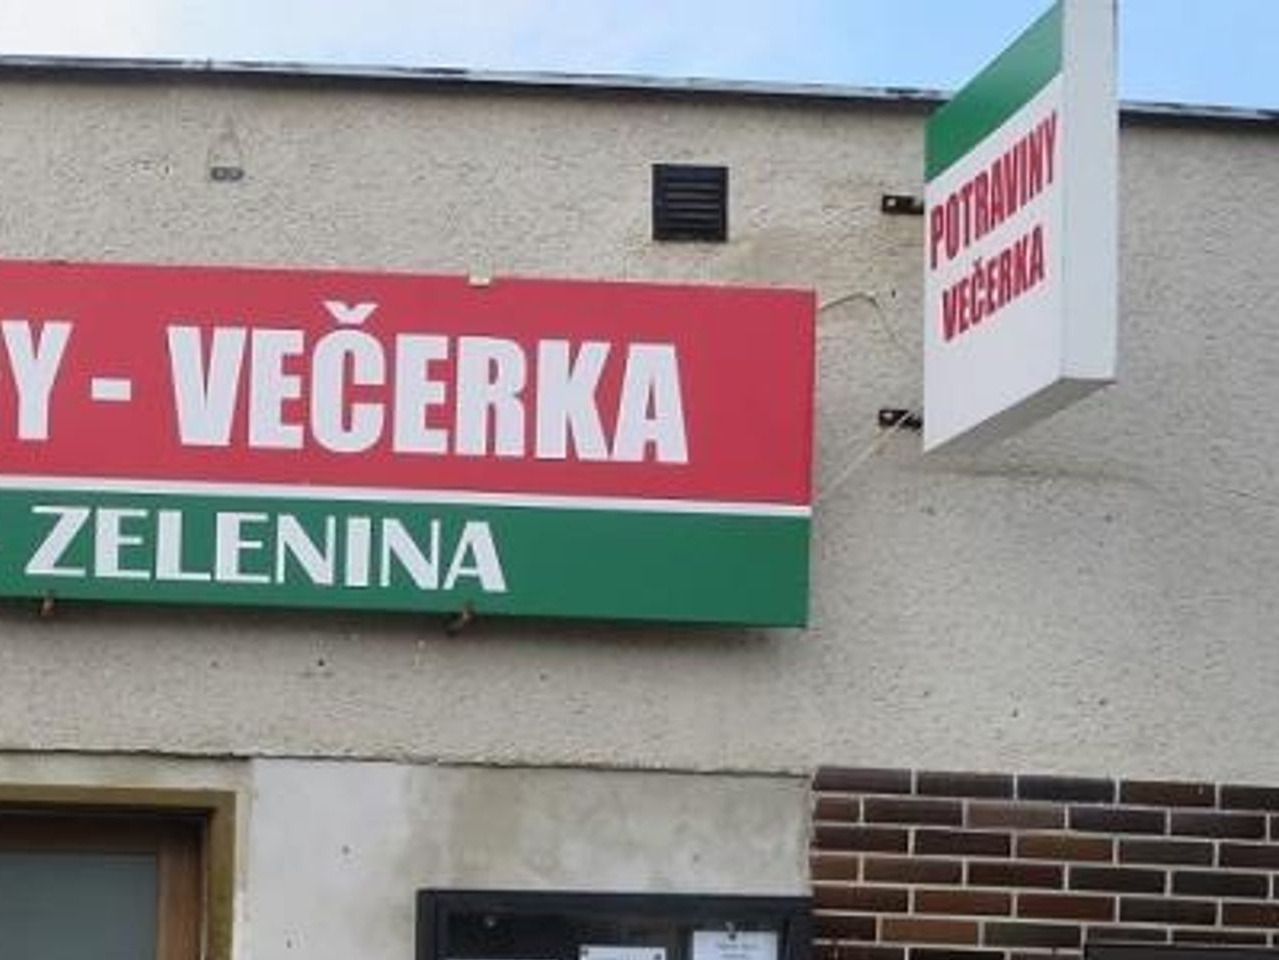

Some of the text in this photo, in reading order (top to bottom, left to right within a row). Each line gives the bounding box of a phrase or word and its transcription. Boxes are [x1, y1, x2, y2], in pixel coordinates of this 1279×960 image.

[929, 111, 1058, 270] POTRAVINY
[941, 223, 1046, 342] VEČERKA
[166, 300, 690, 465] VEČERKA
[25, 505, 509, 592] ZELENINA
